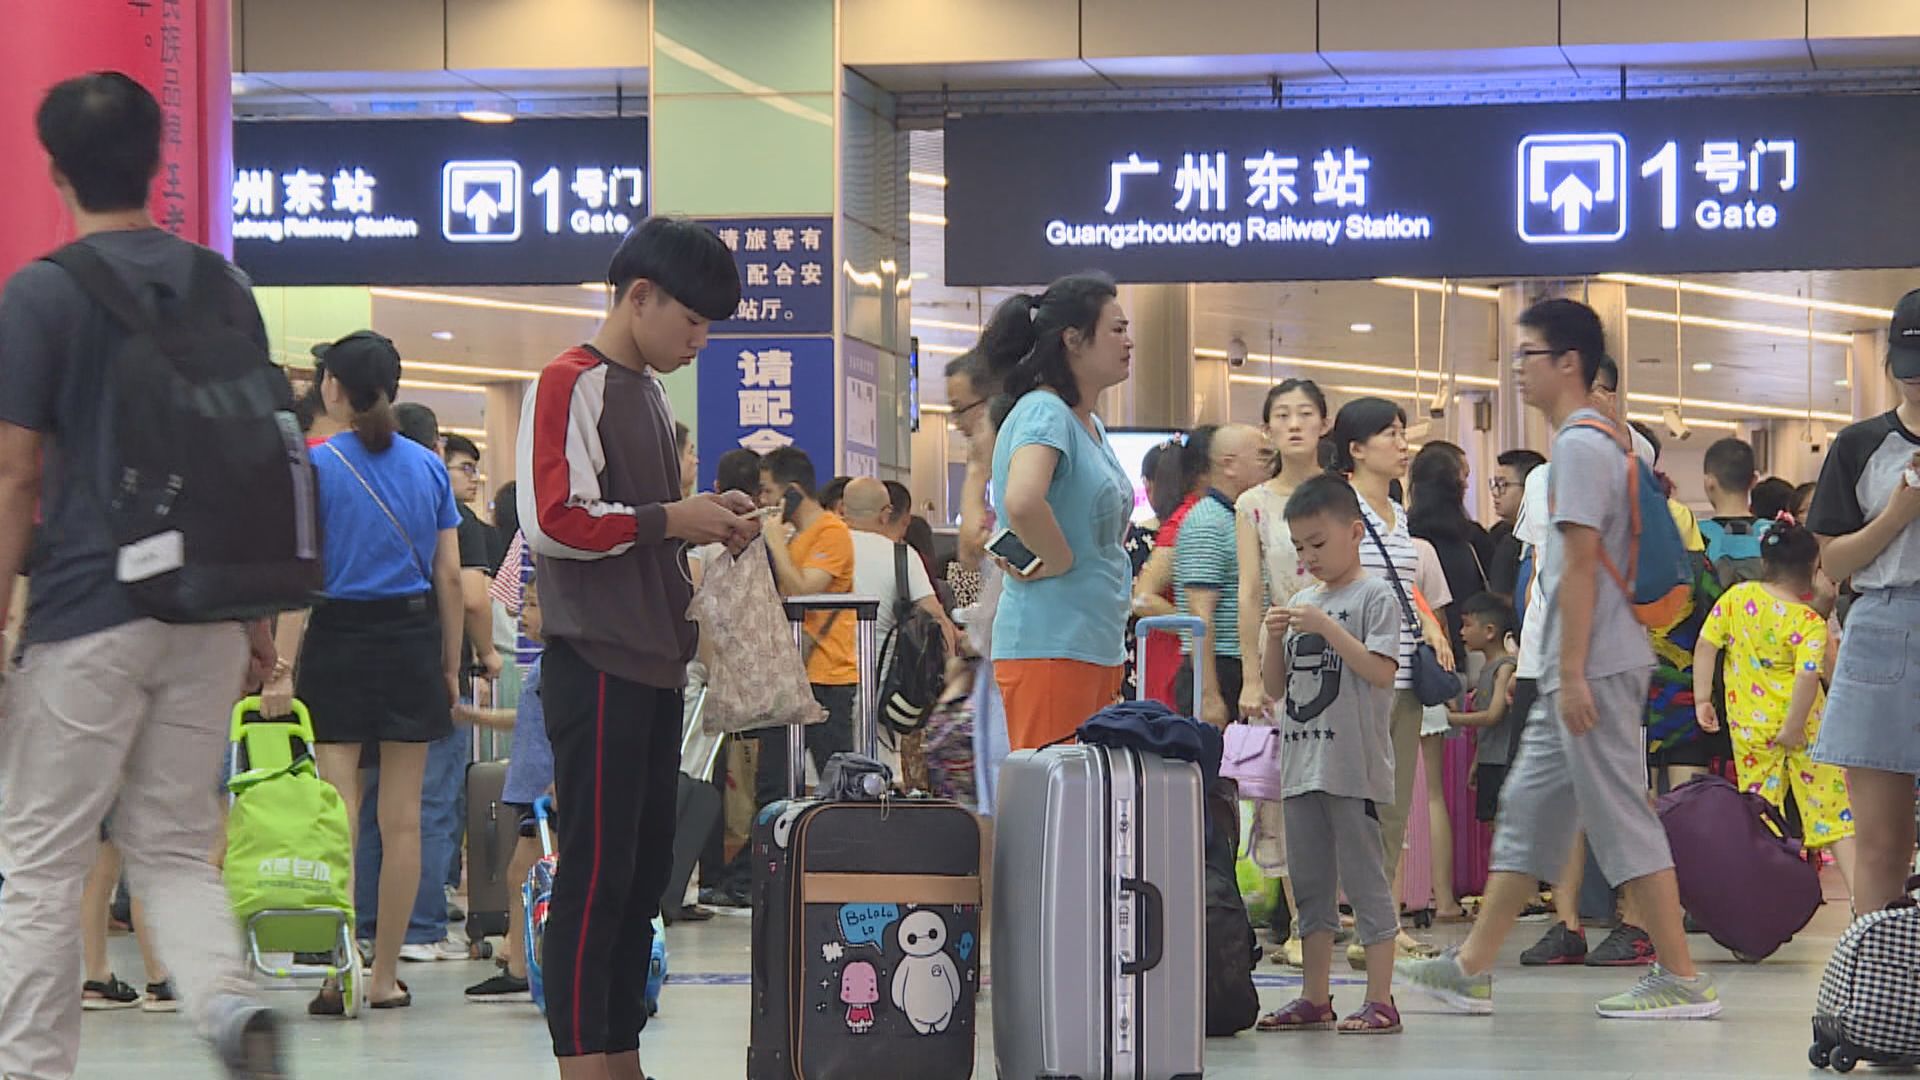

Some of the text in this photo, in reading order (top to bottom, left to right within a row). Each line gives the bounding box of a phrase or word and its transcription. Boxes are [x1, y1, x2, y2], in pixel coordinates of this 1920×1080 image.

[1105, 148, 1369, 213] 广州东站
[571, 210, 630, 233] Gate
[1695, 200, 1777, 229] Gate
[284, 217, 354, 241] Railway
[355, 216, 418, 238] Station
[1046, 214, 1430, 249] Guangzhoudong Railway Station
[746, 262, 821, 286] 配合安
